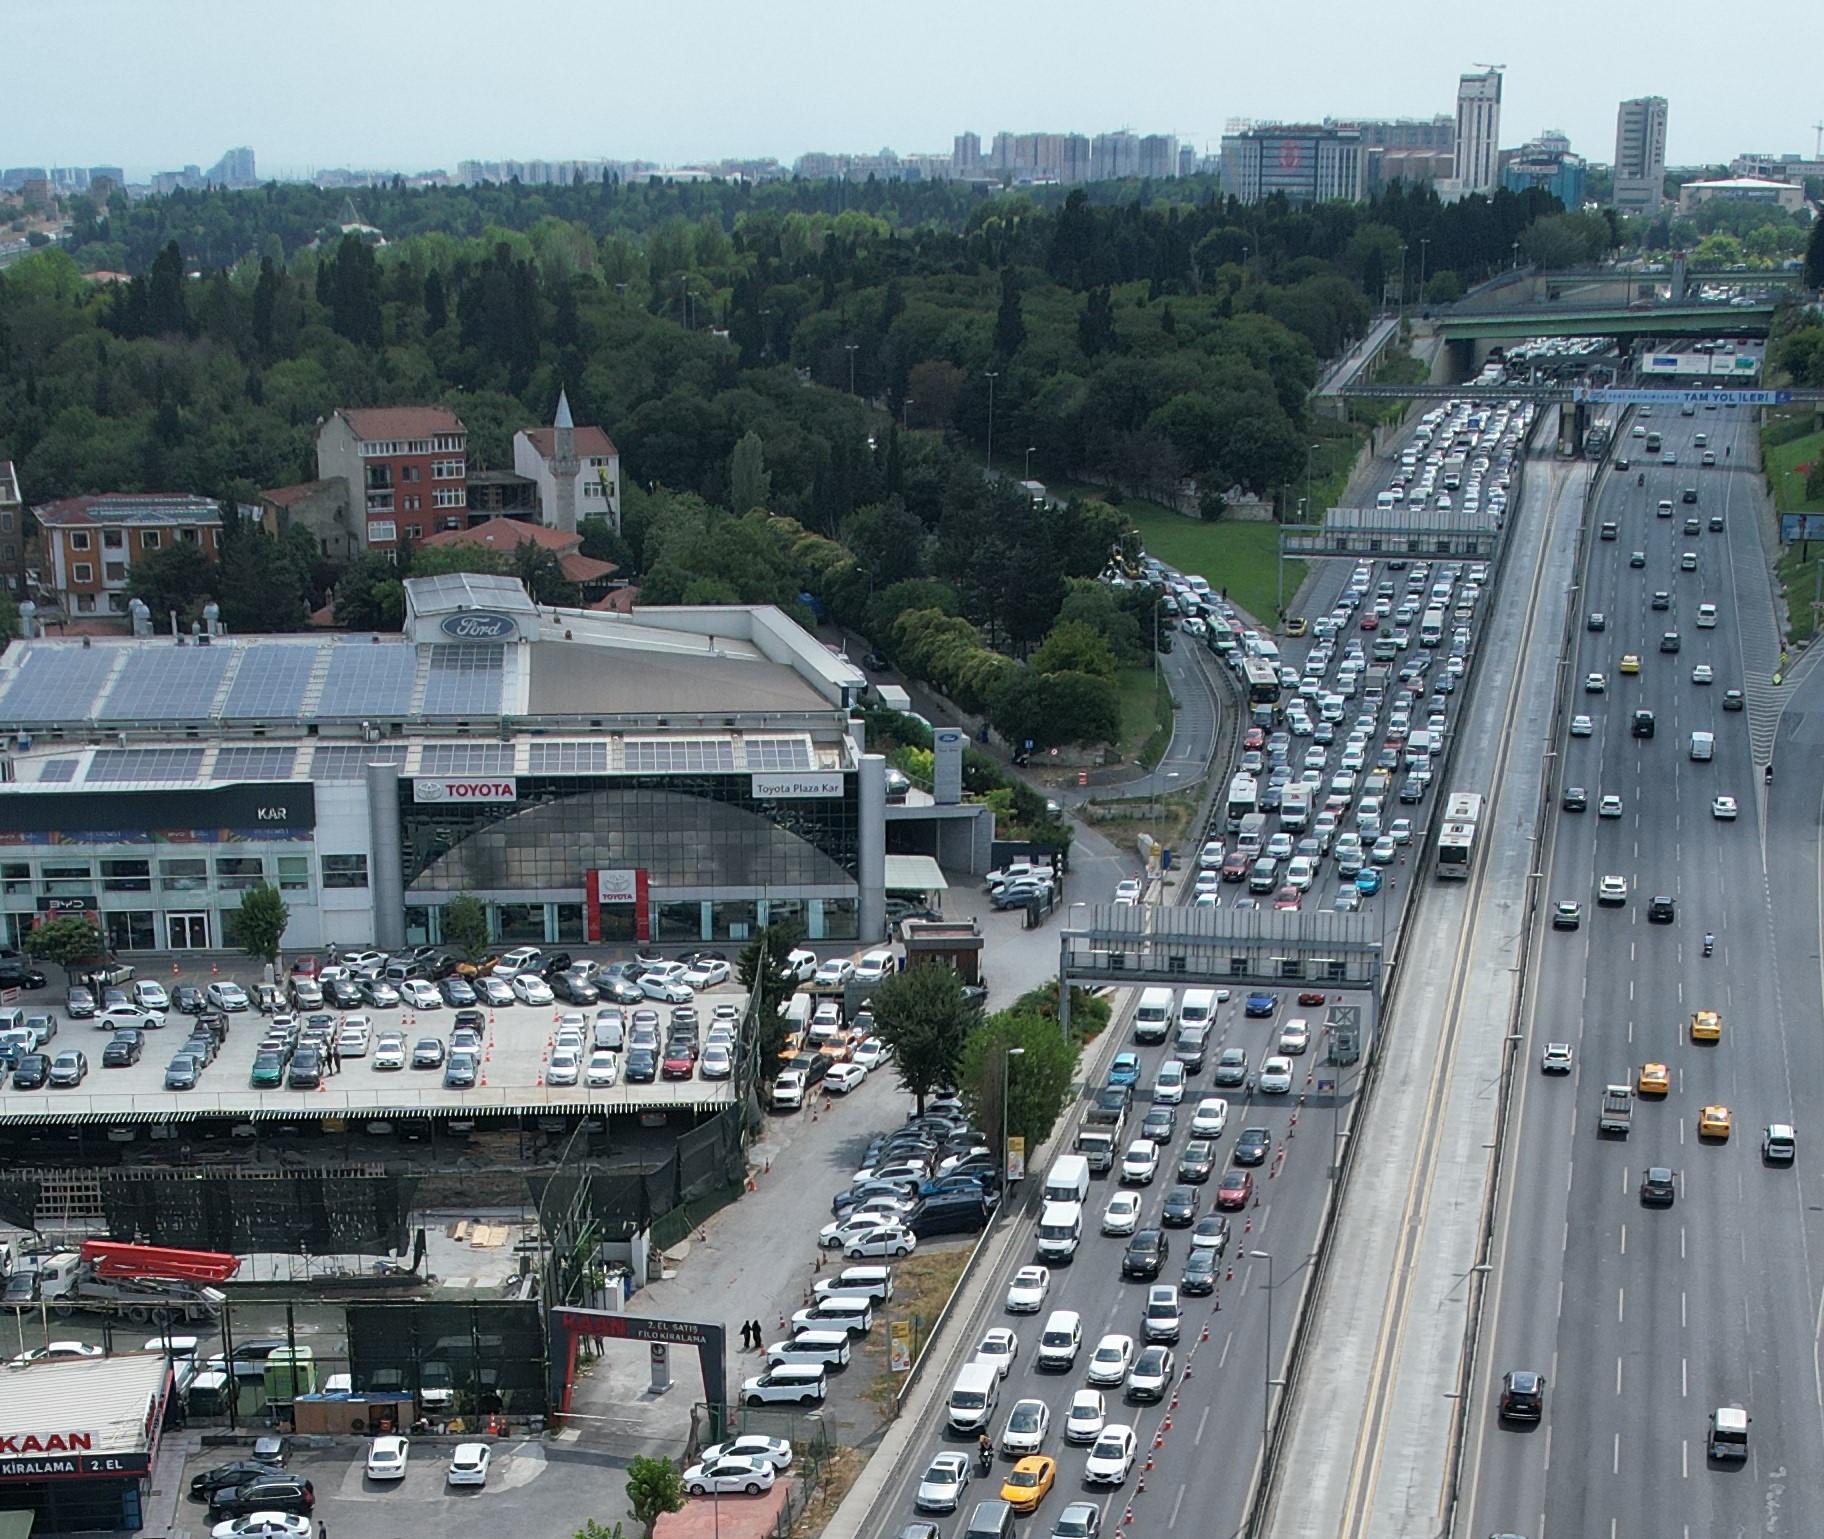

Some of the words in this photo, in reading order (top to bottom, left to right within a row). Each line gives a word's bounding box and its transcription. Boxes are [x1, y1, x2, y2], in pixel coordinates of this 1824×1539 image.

[1684, 393, 1709, 401] TAM
[1712, 393, 1735, 401] YOL
[1739, 392, 1768, 401] İLERİ
[457, 618, 501, 635] Ford
[445, 784, 513, 796] TOYOTA
[758, 785, 790, 795] Toyota
[794, 784, 819, 792] Plaza
[822, 784, 839, 792] Kar
[257, 808, 286, 820] KAR
[49, 900, 84, 908] BYD
[562, 1313, 626, 1334] KAAN
[657, 1322, 669, 1330] EL
[672, 1323, 699, 1334] SATIŞ
[638, 1329, 658, 1339] FİLO
[659, 1331, 707, 1344] KİRALAMA
[2, 1461, 74, 1474] KİRALAMA
[91, 1461, 104, 1471] 2.
[106, 1459, 123, 1470] EL
